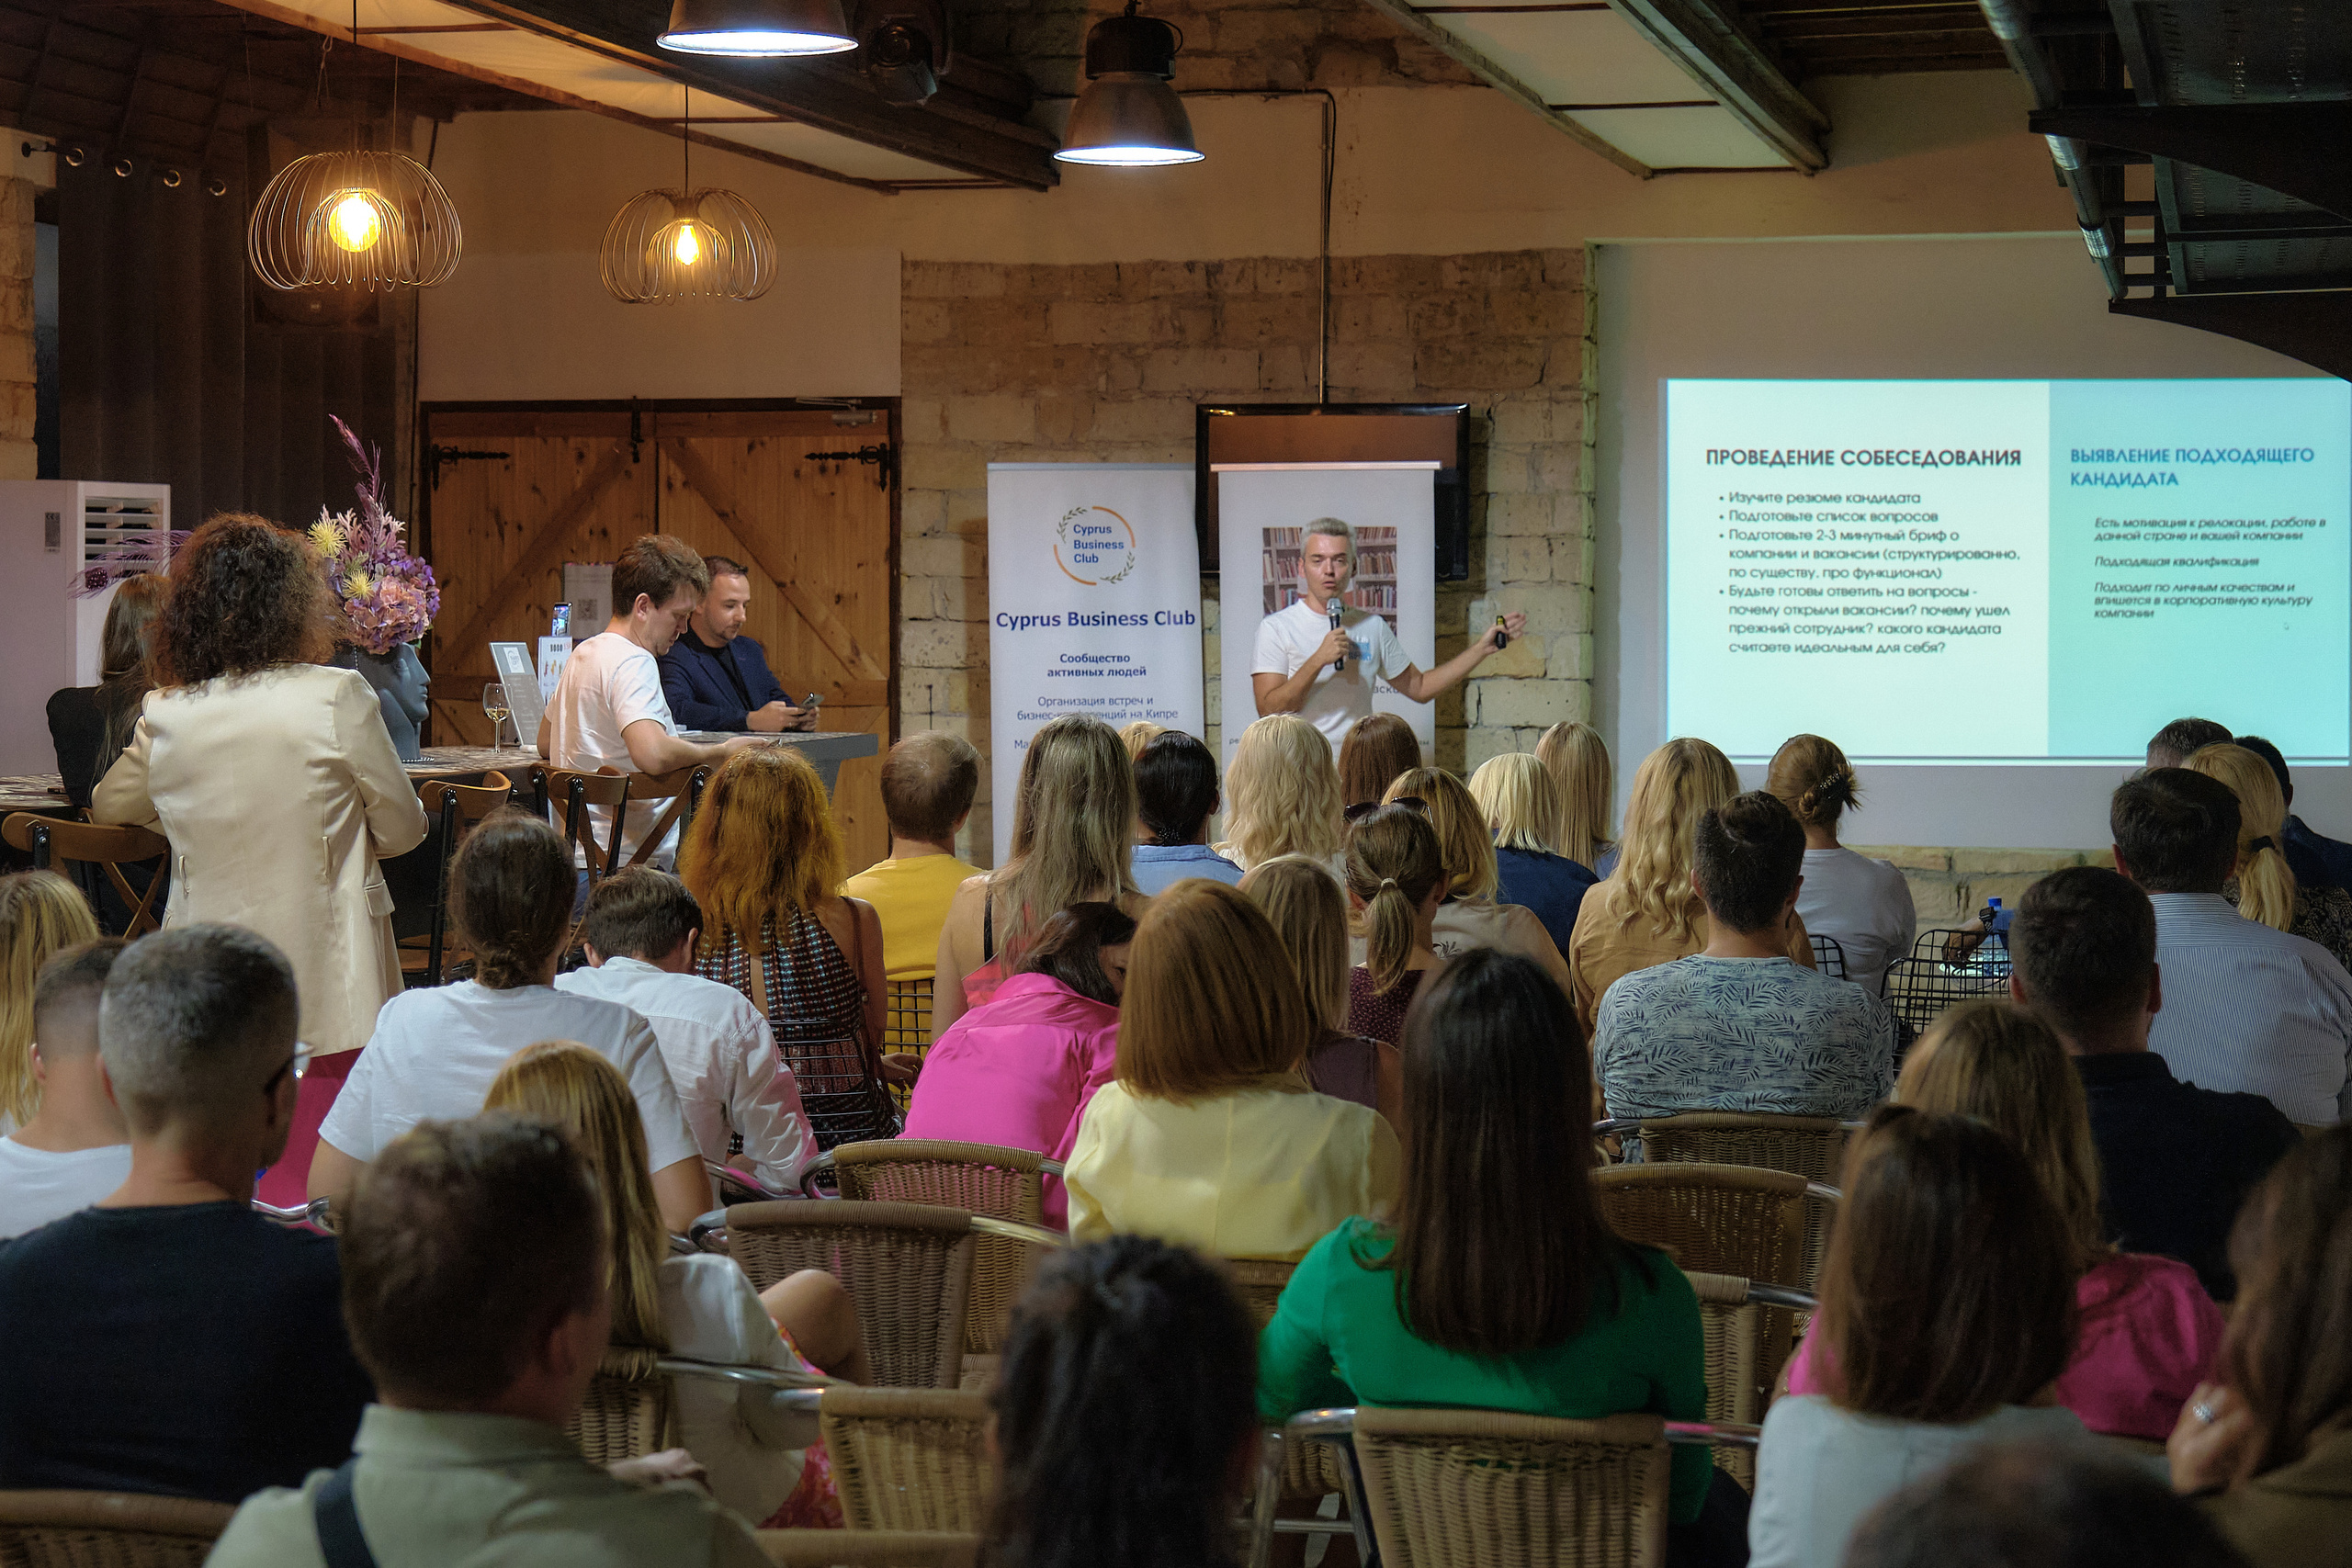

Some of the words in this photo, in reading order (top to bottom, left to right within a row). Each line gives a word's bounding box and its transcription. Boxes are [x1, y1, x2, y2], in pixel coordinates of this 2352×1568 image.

[1706, 449, 1835, 468] ПРОВЕДЕНИЕ
[1840, 449, 2021, 468] СОБЕСЕДОВАНИЯ
[2071, 448, 2170, 463] ВЫЯВЛЕНИЕ
[2176, 447, 2315, 465] ПОДХОДЯЩЕГО
[2071, 472, 2179, 489] КАНДИДАТА
[1729, 491, 1783, 505] Изучите
[1786, 494, 1843, 505] резюме
[1846, 494, 1921, 504] кандидата
[1729, 509, 1814, 523] Подготовьте
[1815, 513, 1867, 522] список
[1870, 513, 1939, 524] вопросов
[2095, 517, 2120, 528] Есть
[2122, 519, 2188, 529] мотивация
[2270, 516, 2317, 529] работе
[2319, 519, 2326, 527] в
[1073, 524, 1112, 536] Cyprus
[1729, 528, 1814, 541] Подготовьте
[1816, 529, 1837, 541] 2-3
[1839, 529, 1905, 543] минутный
[1909, 529, 1948, 543] бриф
[1950, 531, 1960, 541] о
[2094, 531, 2142, 542] данной
[2143, 533, 2188, 542] стране
[2199, 531, 2241, 541] вашей
[2243, 533, 2303, 541] компании
[1073, 539, 1125, 549] Business
[1073, 553, 1099, 563] Club
[1729, 549, 1797, 559] компании
[1801, 550, 1810, 558] и
[1813, 550, 1880, 559] вакансии
[2095, 556, 2171, 568] Подходящая
[2172, 557, 2260, 569] квалификация
[1729, 569, 1747, 578] по
[1823, 569, 1849, 581] про
[1852, 567, 1942, 581] функционал)
[1729, 584, 1775, 598] Будьте
[1779, 587, 1824, 597] готовы
[1826, 588, 1883, 597] ответить
[1886, 588, 1905, 597] на
[1907, 588, 1970, 599] вопросы
[2094, 581, 2153, 593] Подходит
[2154, 584, 2171, 592] по
[2172, 584, 2218, 592] личным
[2220, 584, 2285, 592] качествам
[2094, 597, 2152, 605] впишется
[2154, 597, 2161, 605] в
[2163, 596, 2259, 607] корпоративную
[2261, 596, 2313, 607] культуру
[1729, 606, 1780, 617] почему
[1783, 606, 1839, 617] открыли
[1842, 604, 1917, 615] вакансии?
[1920, 606, 1972, 617] почему
[1974, 606, 2010, 617] ушел
[2094, 610, 2154, 618] компании
[996, 613, 1061, 631] Cyprus
[1068, 611, 1148, 626] Business
[1154, 610, 1195, 626] Club
[1729, 623, 1791, 635] прежний
[1793, 623, 1874, 636] сотрудник?
[1877, 625, 1924, 634] какого
[1926, 625, 2002, 636] кандидата
[1729, 643, 1792, 653] считаете
[1794, 644, 1873, 654] идеальным
[1875, 644, 1901, 654] для
[1904, 641, 1946, 653] себя?
[1059, 653, 1131, 664] Сообщество
[1047, 669, 1104, 677] активных
[1106, 666, 1147, 678] людей
[1037, 696, 1105, 708] Организация
[1108, 697, 1144, 707] встреч
[1147, 709, 1178, 720] Кипре
